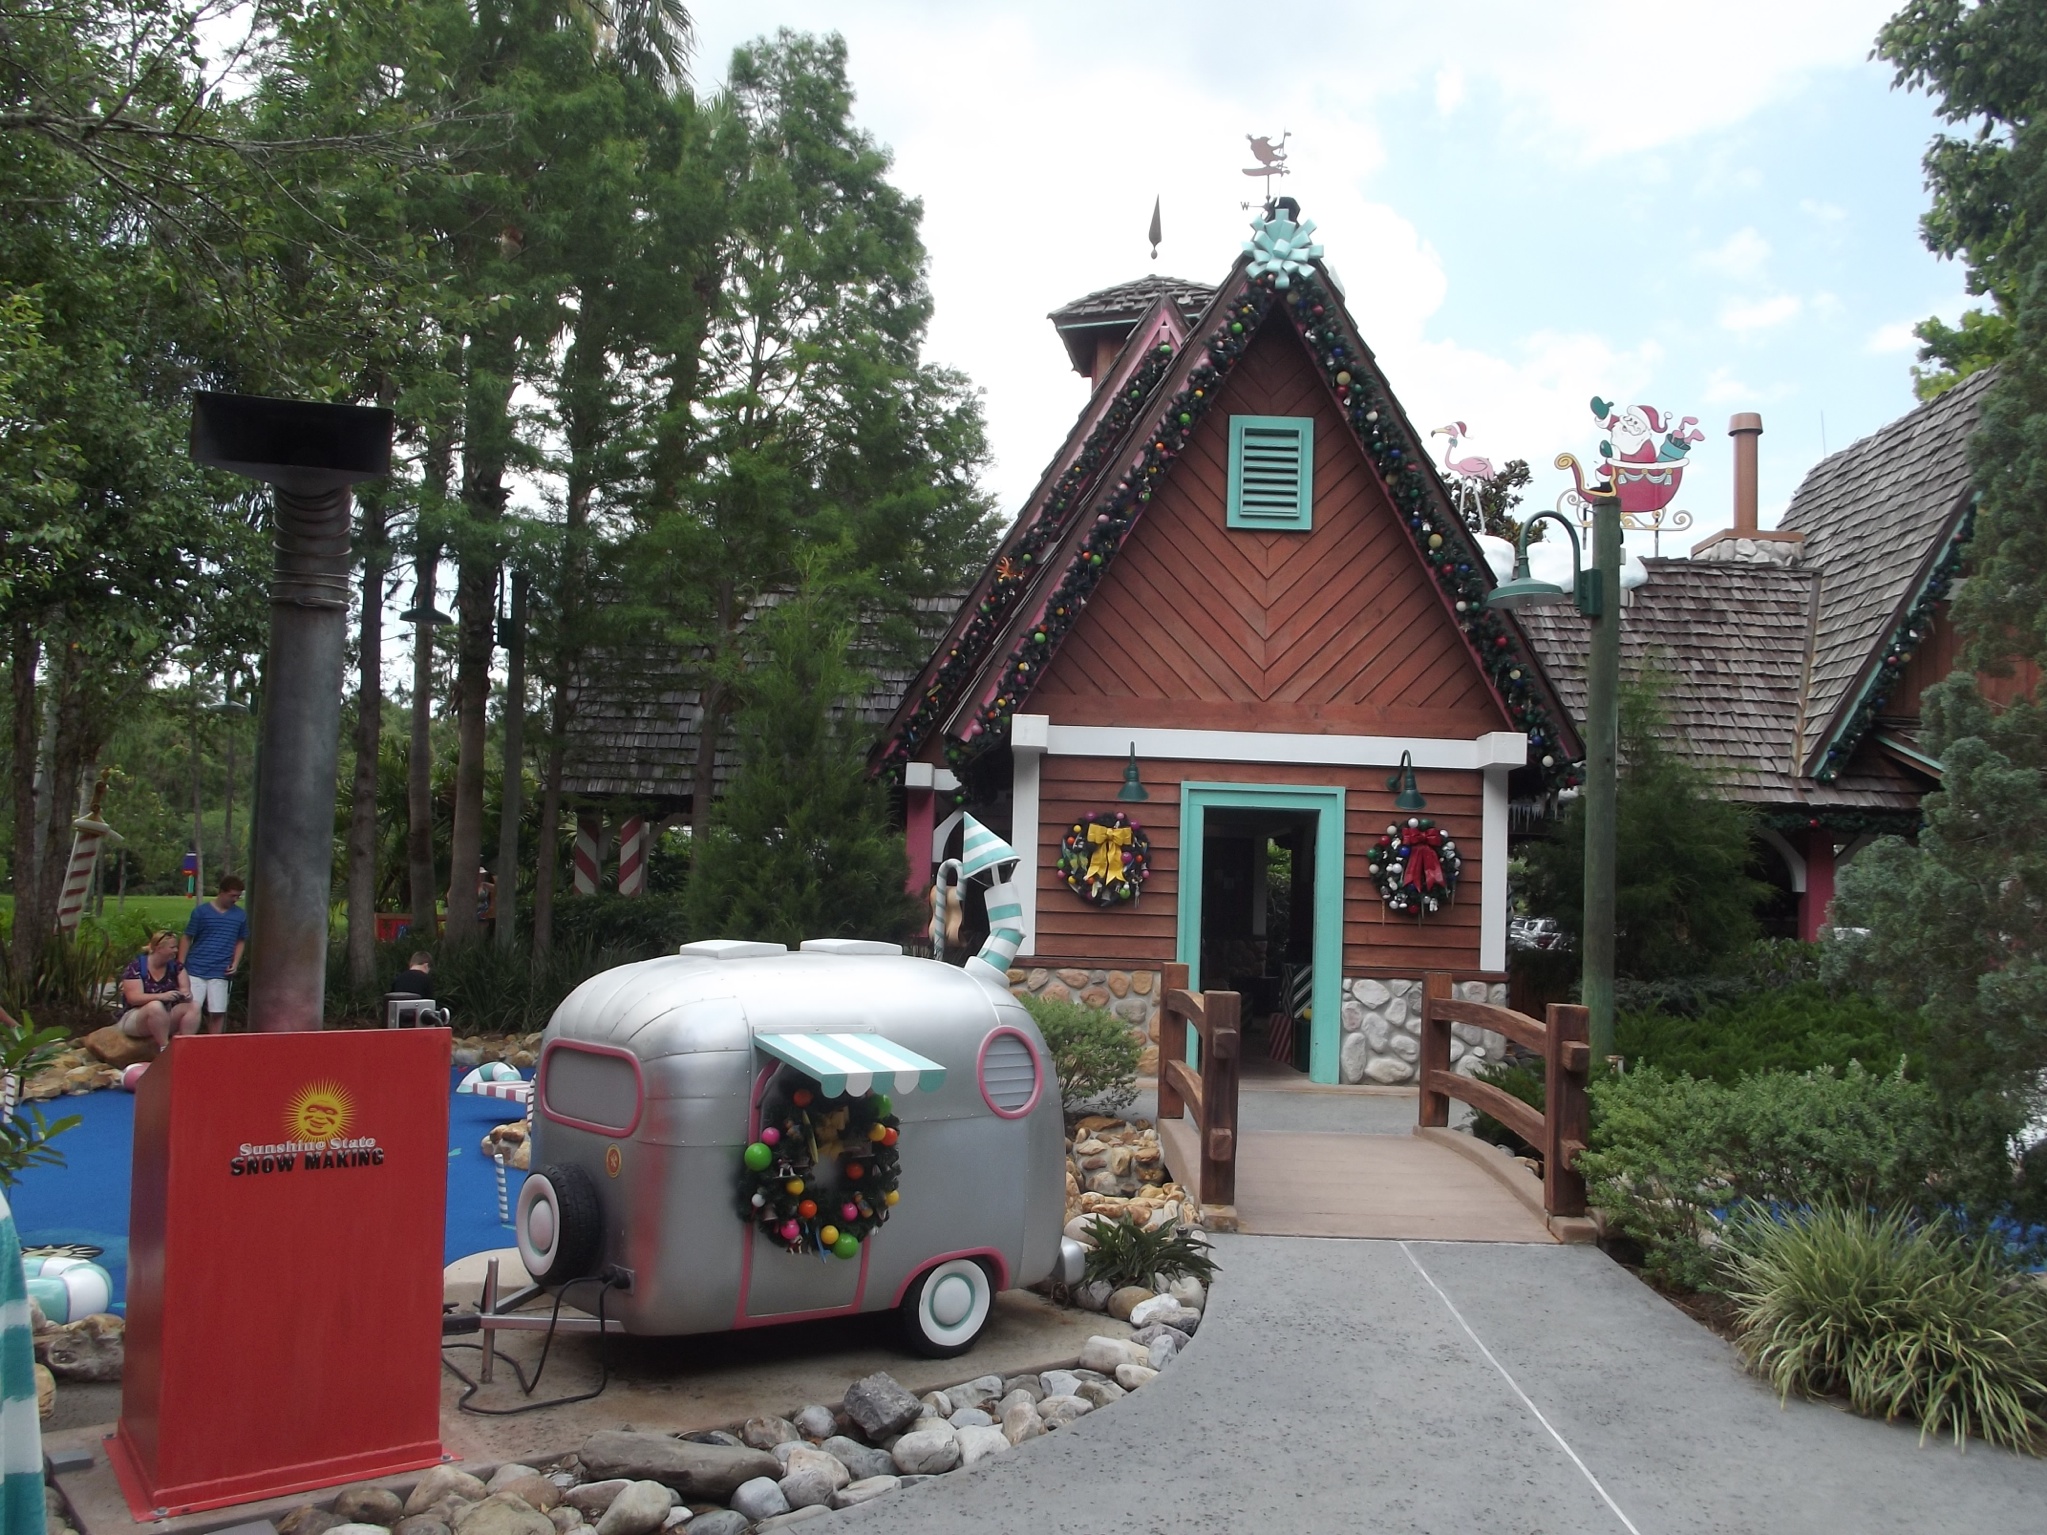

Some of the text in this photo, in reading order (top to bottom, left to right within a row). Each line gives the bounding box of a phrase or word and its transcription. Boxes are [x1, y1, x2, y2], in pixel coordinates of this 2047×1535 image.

[1240, 201, 1249, 211] W
[240, 1136, 376, 1156] Sunshine State
[230, 1147, 384, 1176] SNOW MAKING
